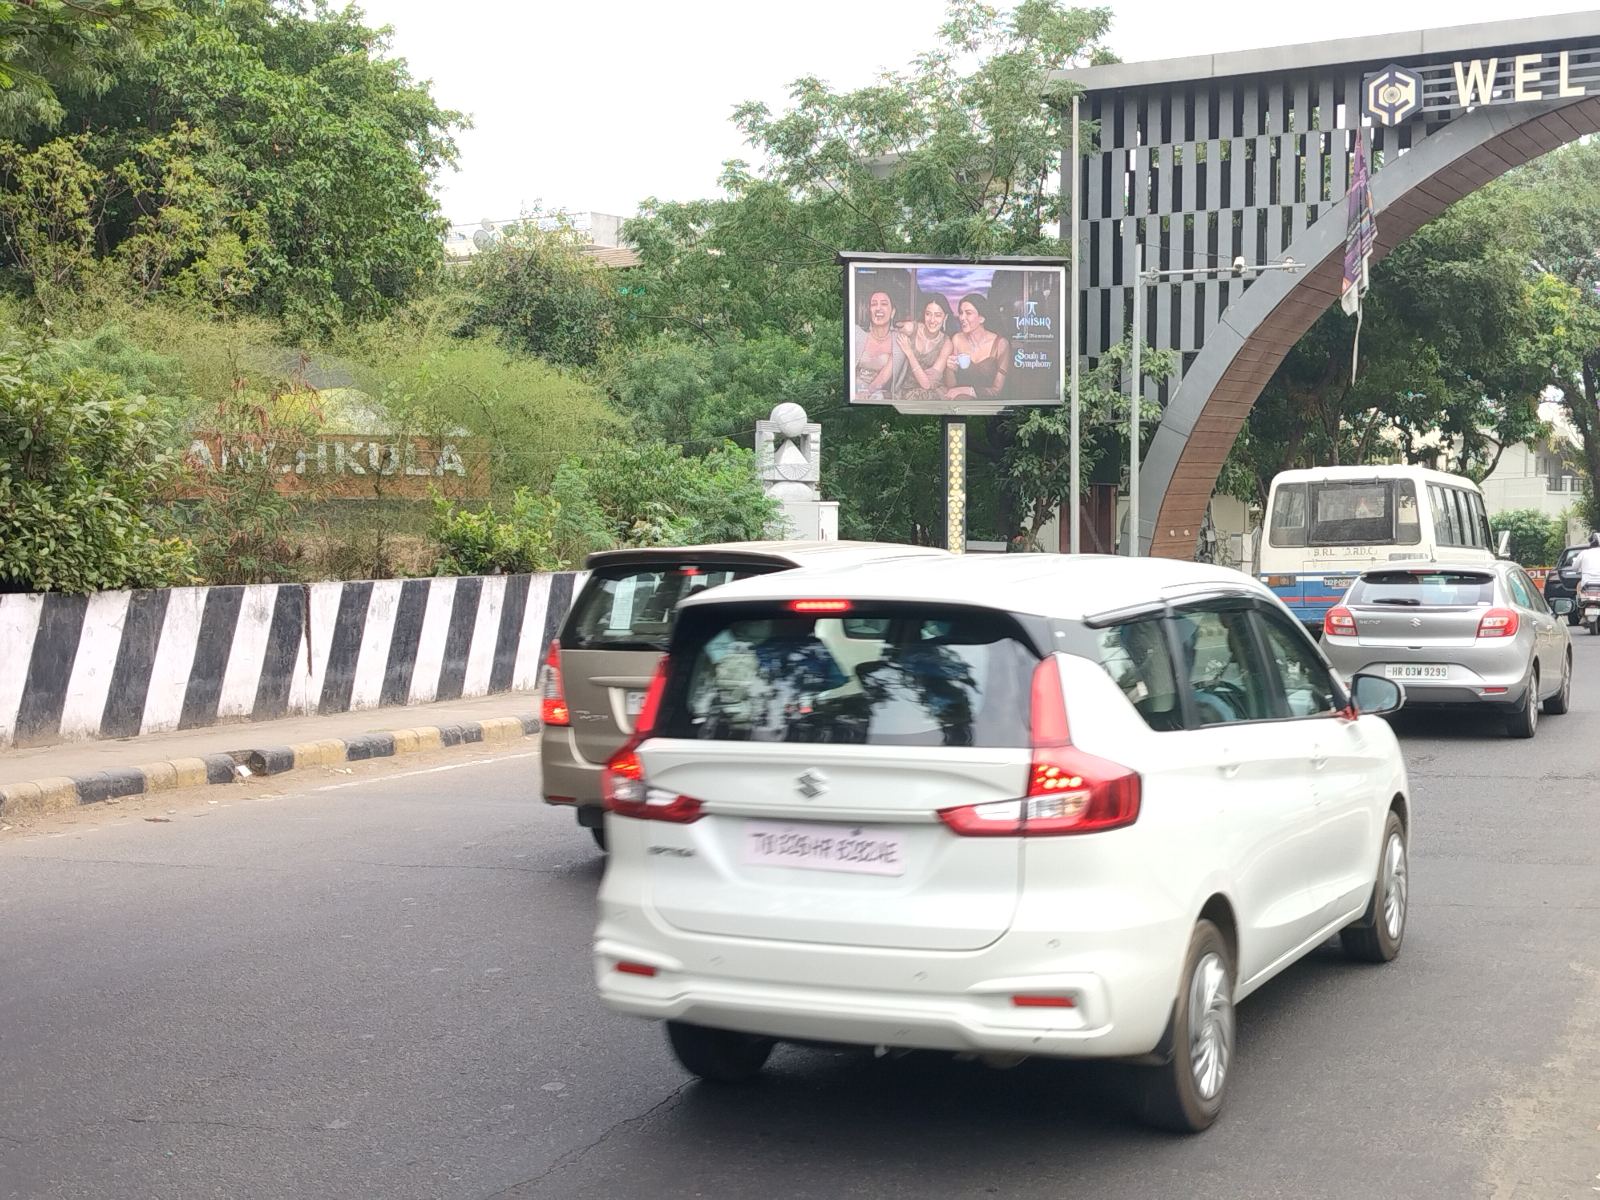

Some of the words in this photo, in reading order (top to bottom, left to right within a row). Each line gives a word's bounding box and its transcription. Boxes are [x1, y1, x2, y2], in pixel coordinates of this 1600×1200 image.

[1453, 50, 1586, 107] WEL
[1014, 354, 1053, 370] Symphony
[1392, 666, 1403, 676] HR
[1424, 667, 1447, 677] 9299
